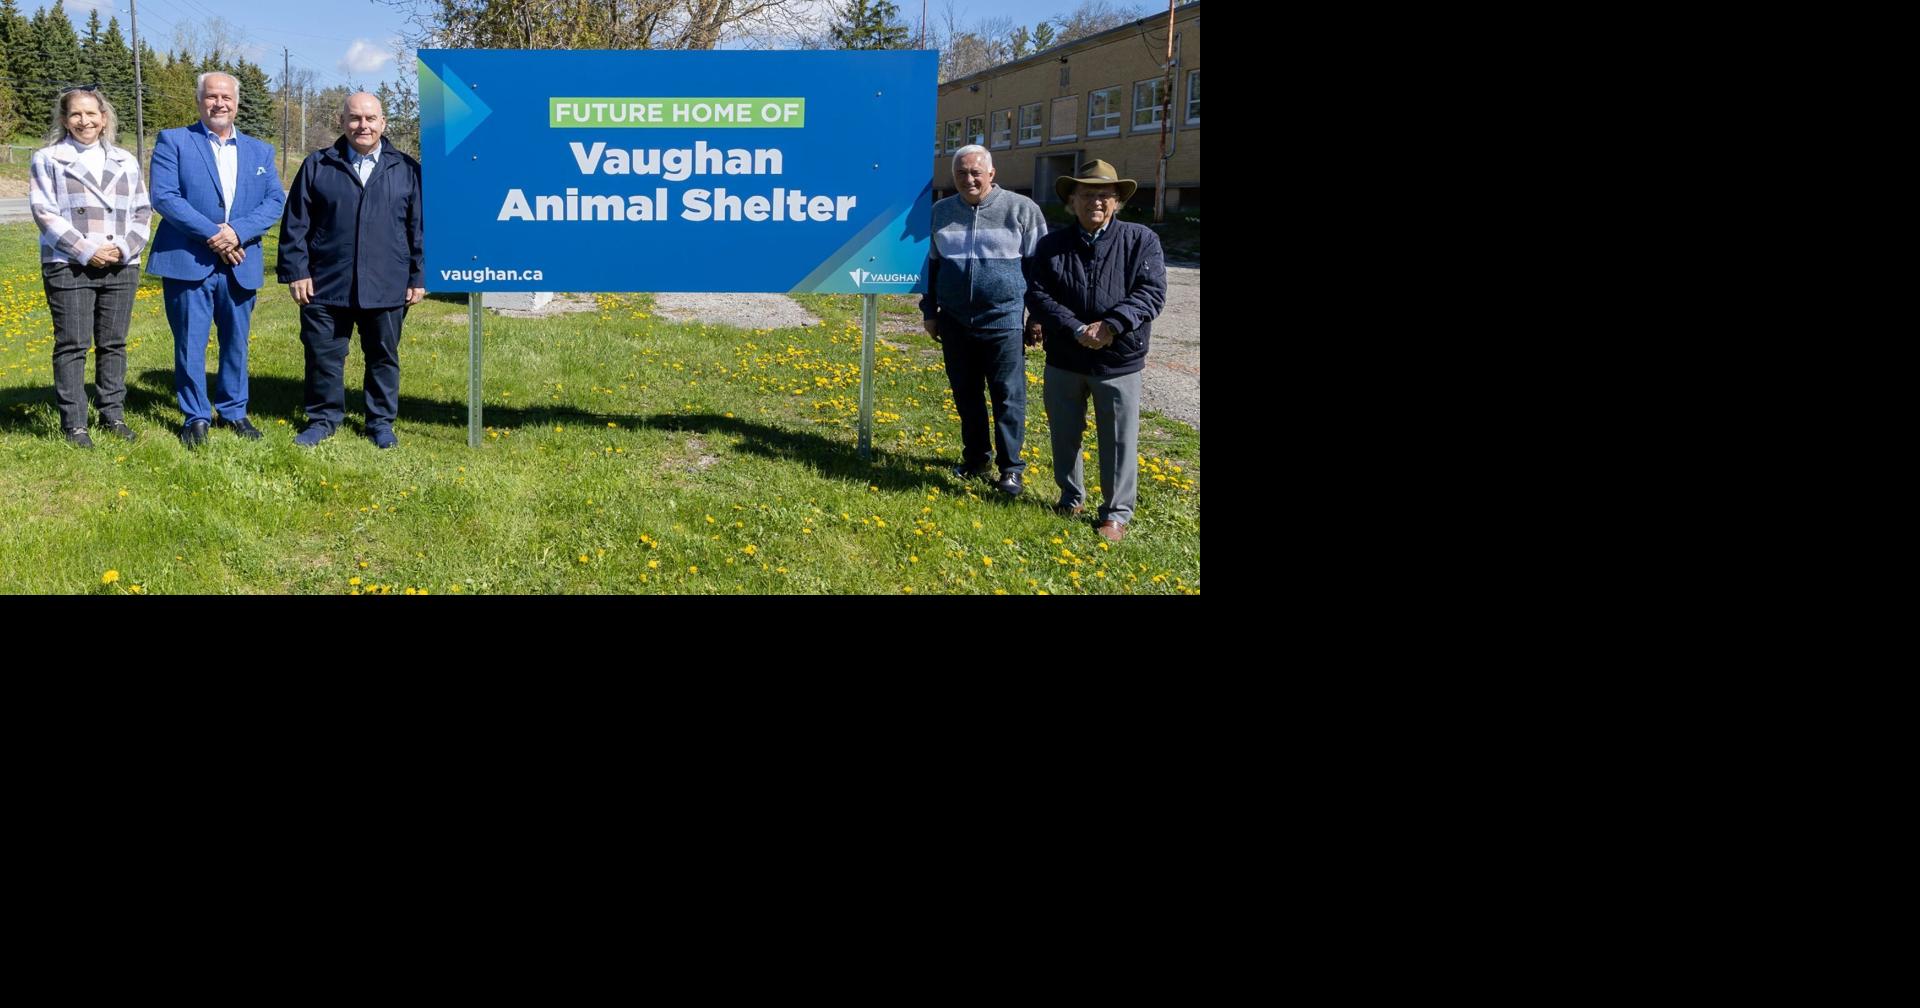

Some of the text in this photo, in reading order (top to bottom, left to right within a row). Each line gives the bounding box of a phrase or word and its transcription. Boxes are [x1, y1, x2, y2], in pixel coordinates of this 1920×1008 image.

[555, 103, 799, 122] FUTURE HOME OF
[570, 141, 783, 182] Vaughan
[497, 187, 857, 222] Animal Shelter
[440, 266, 543, 284] vaughan.ca
[870, 273, 921, 282] VAUGHAN
